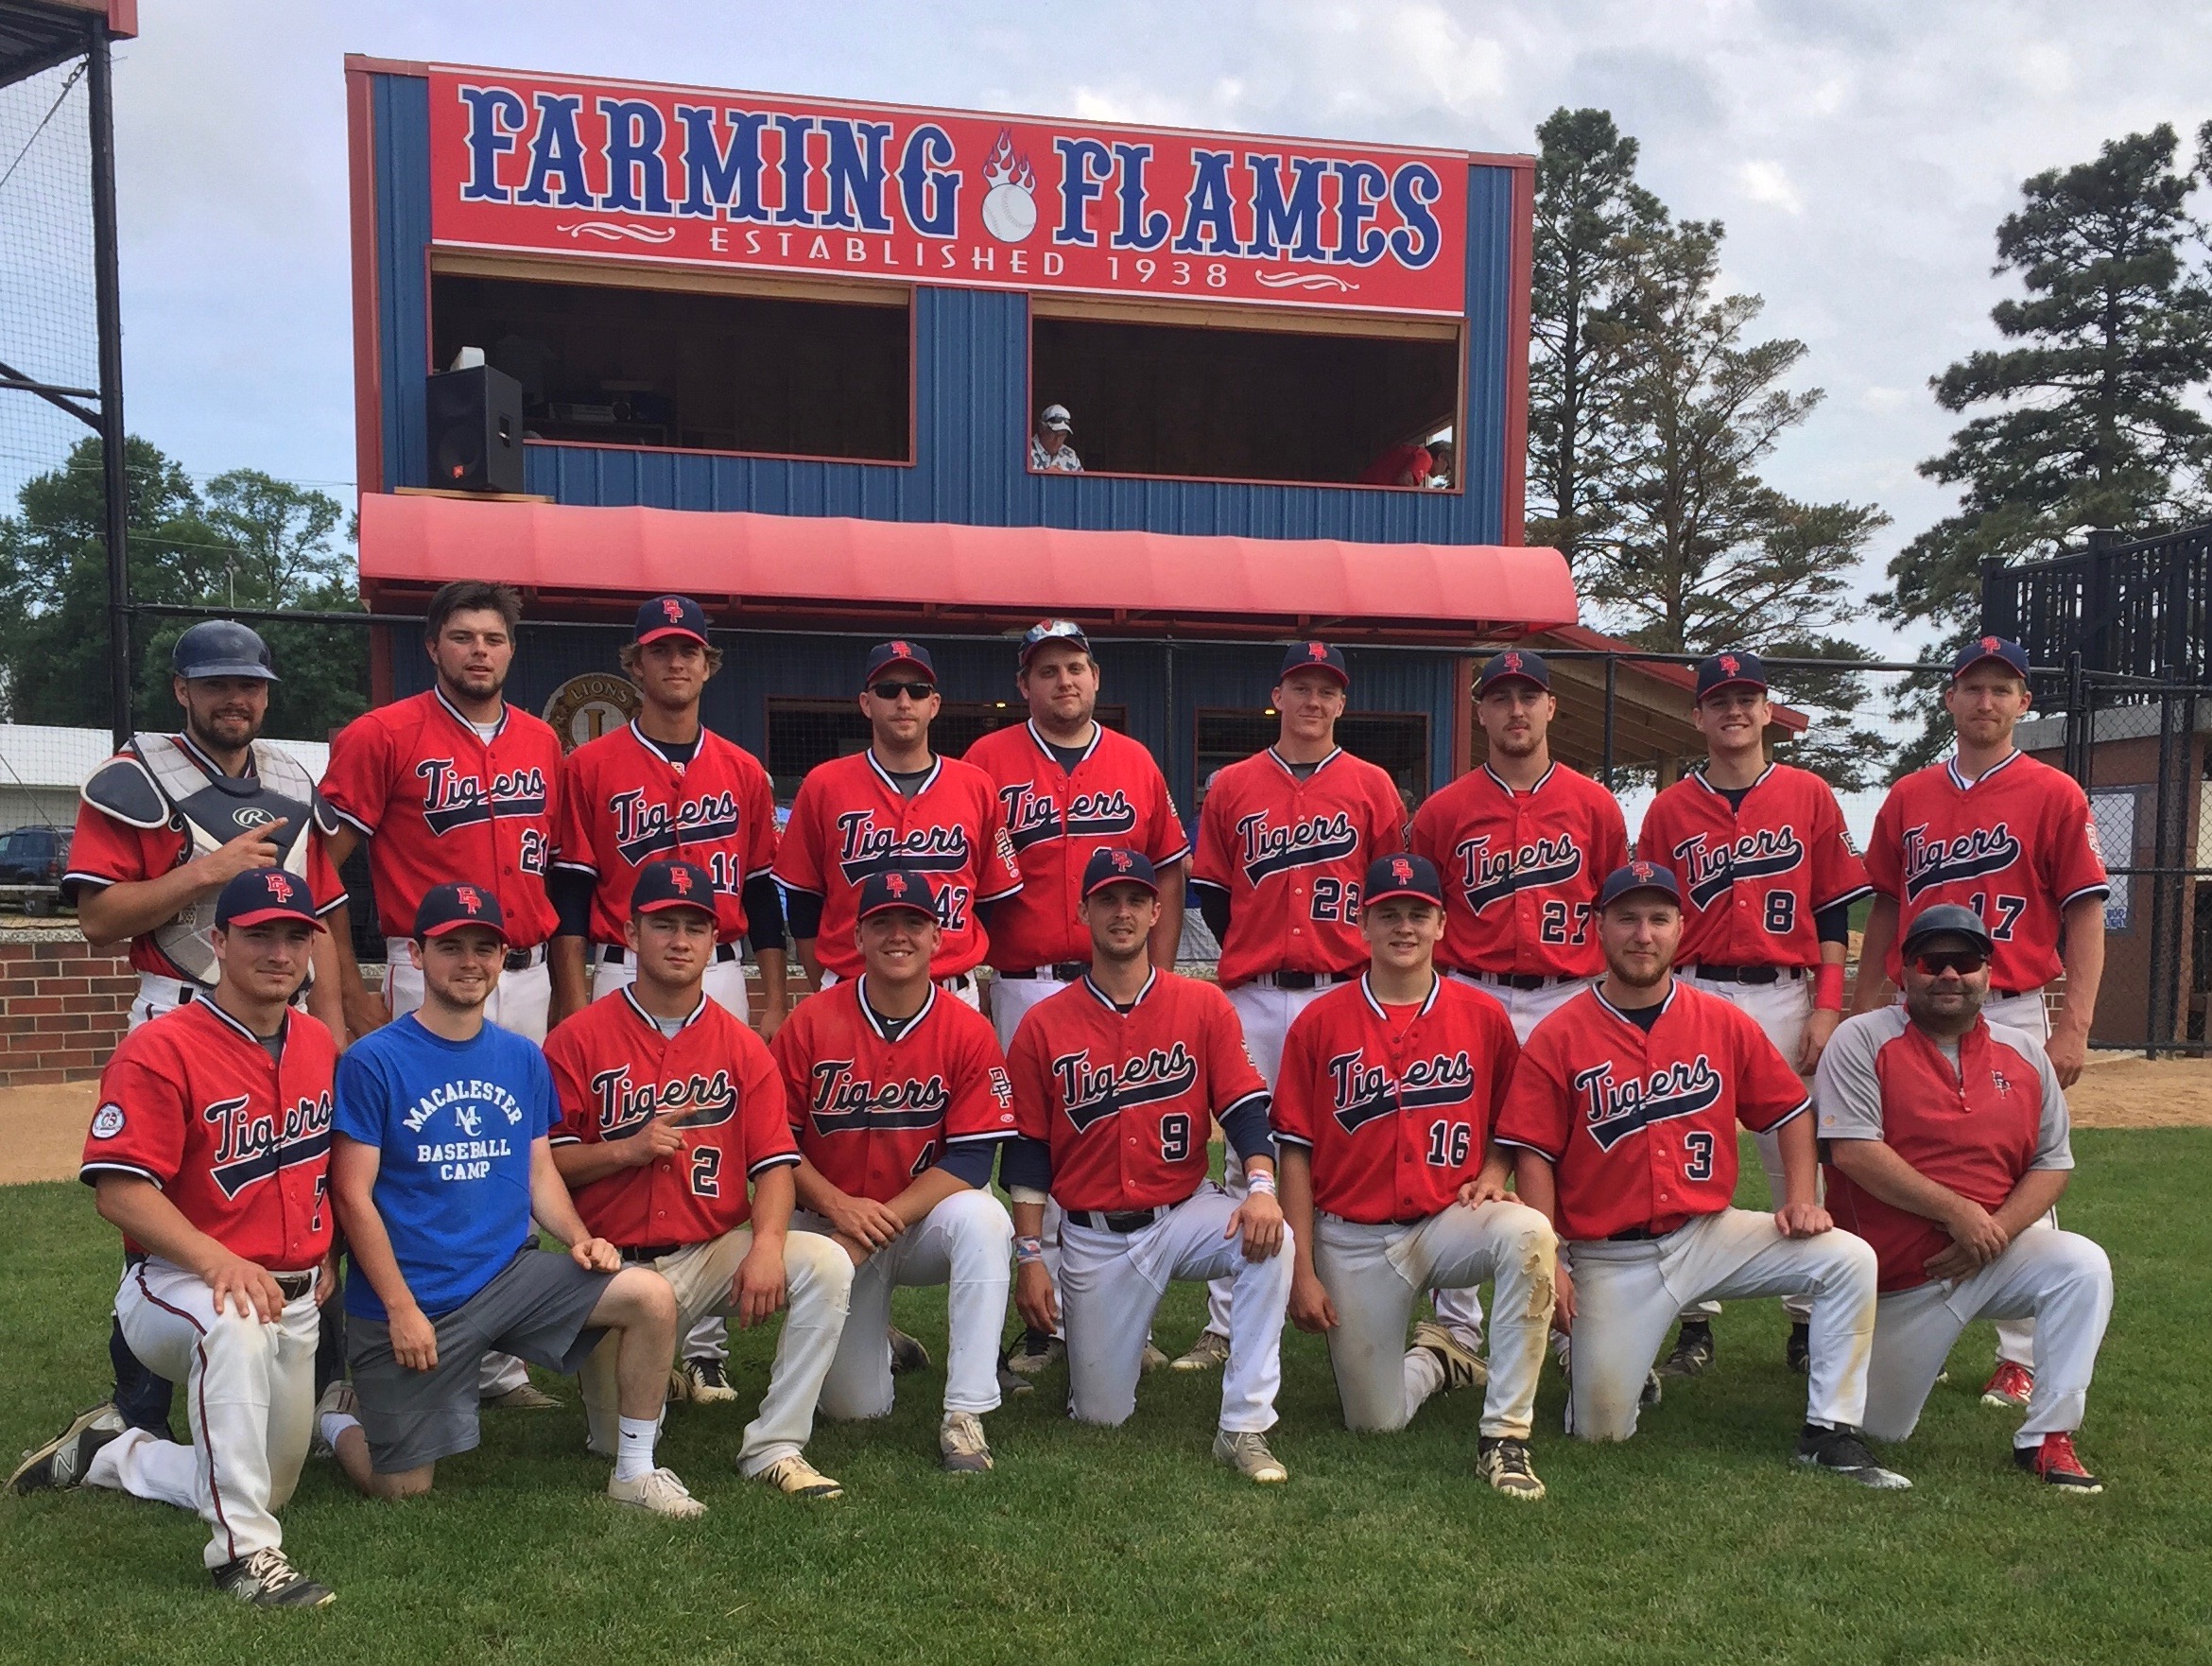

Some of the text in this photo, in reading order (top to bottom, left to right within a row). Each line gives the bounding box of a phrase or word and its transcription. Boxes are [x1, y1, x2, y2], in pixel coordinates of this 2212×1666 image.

[458, 84, 1442, 270] FARMING FLAMES
[709, 227, 1227, 288] ESTABLISHED 1938
[570, 680, 630, 702] LIONS
[416, 757, 545, 809] Tigers
[999, 780, 1132, 831] Tigers
[610, 787, 738, 843] Tigers
[838, 808, 967, 859] Tigers
[1236, 809, 1355, 862] Tigers
[709, 852, 740, 895] 11
[1457, 833, 1581, 887] Tigers
[1673, 824, 1801, 887] Tigers
[1902, 822, 2017, 882] Tigers
[934, 883, 969, 931] 42
[1310, 876, 1362, 925] 22
[1540, 900, 1591, 945] 27
[1763, 889, 1795, 934] 8
[1969, 892, 2027, 941] 17
[591, 1063, 736, 1128] Tigers
[812, 1057, 950, 1112] Tigers
[1053, 1041, 1197, 1106] Tigers
[1328, 1047, 1475, 1109] Tigers
[1575, 1053, 1721, 1122] Tigers
[204, 1088, 332, 1164] Tigers
[403, 1080, 523, 1133] MACALESTER
[455, 1105, 482, 1137] MC
[417, 1138, 511, 1162] BASEBALL
[1160, 1112, 1191, 1162] 9
[1426, 1119, 1471, 1168] 16
[1685, 1131, 1715, 1181] 3
[441, 1160, 491, 1181] CAMP
[691, 1144, 722, 1199] 2
